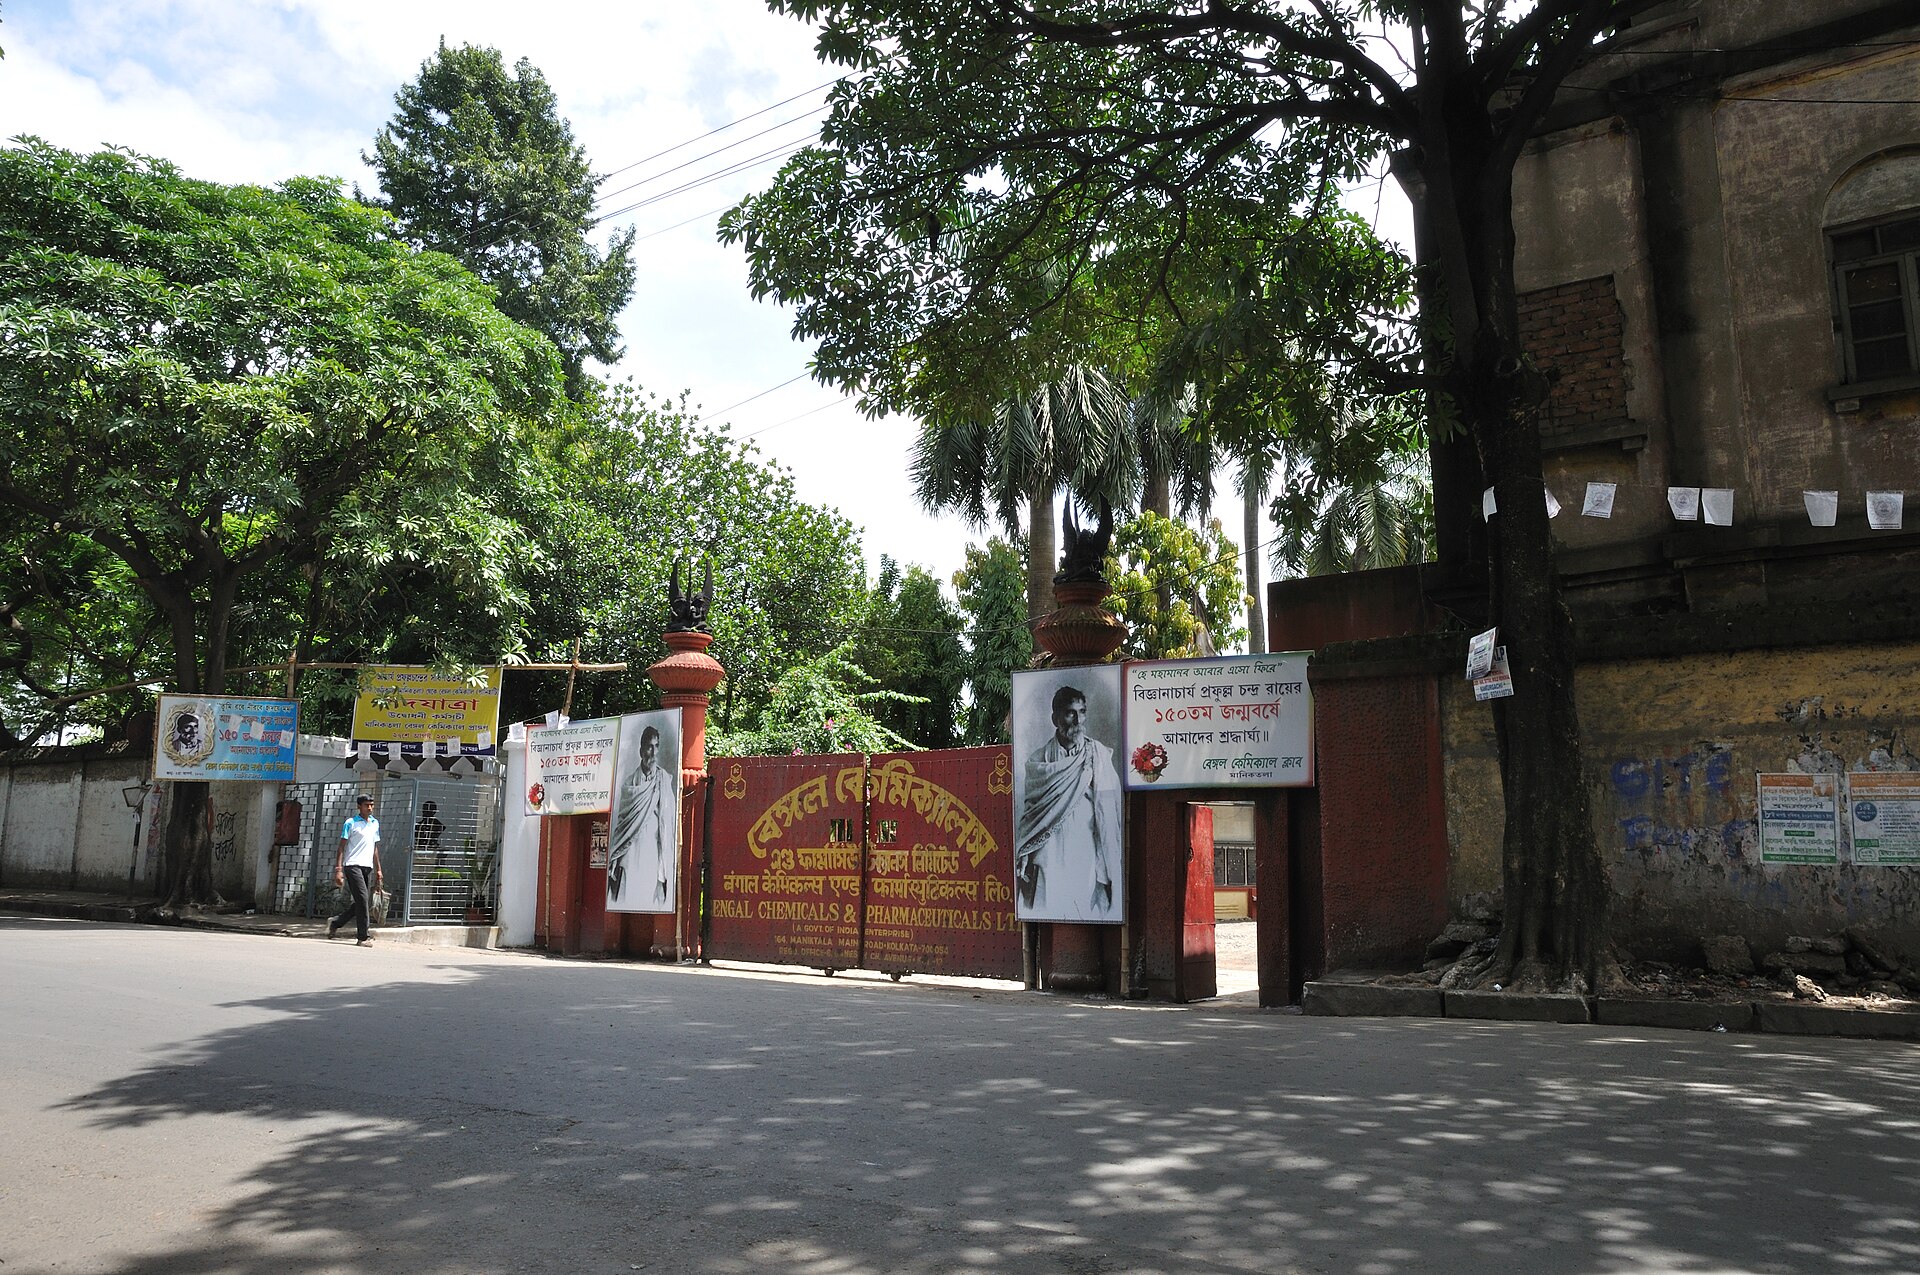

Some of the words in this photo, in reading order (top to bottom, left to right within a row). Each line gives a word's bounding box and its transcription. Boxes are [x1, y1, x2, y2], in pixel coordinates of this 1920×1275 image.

[1150, 668, 1190, 679] মহামানব
[1193, 666, 1225, 677] আবার
[1227, 665, 1251, 675] এসো
[1132, 683, 1197, 700] বিজ্ঞানাচার্য
[1200, 685, 1234, 703] প্রফুল্ল
[1238, 683, 1261, 696] চন্দ্র
[1265, 681, 1304, 695] রায়ের
[1154, 705, 1215, 723] ১৫০তম
[1219, 697, 1281, 721] জন্মবর্ষে
[530, 740, 564, 754] বিজ্ঞানাচার্য
[565, 741, 582, 754] প্রফুল্ল
[583, 740, 595, 750] চন্দ্র
[596, 738, 614, 749] রায়ের
[1162, 730, 1215, 745] আমাদের
[540, 756, 572, 768] ১৫০তম
[573, 750, 603, 767] জন্মবর্ষে
[1201, 758, 1228, 771] বেঙ্গল
[1231, 752, 1278, 770] কেমিক্যাল
[1281, 756, 1304, 769] ক্লাব
[543, 773, 569, 784] আমাদের
[1230, 771, 1274, 779] মানিকতলা
[747, 774, 829, 859] বেঙ্গল
[723, 870, 759, 895] बंगाल
[762, 869, 826, 896] केमिकल्स
[829, 875, 861, 898] एण्ड
[712, 899, 754, 919] ENGAL
[758, 901, 840, 922] CHEMICALS
[843, 903, 857, 924] &
[865, 904, 992, 931] PHARMACEUTICALS
[996, 912, 1023, 933] LT
[837, 926, 859, 936] INDIA
[790, 936, 833, 946] MANIKTALA
[838, 938, 859, 948] MAIN
